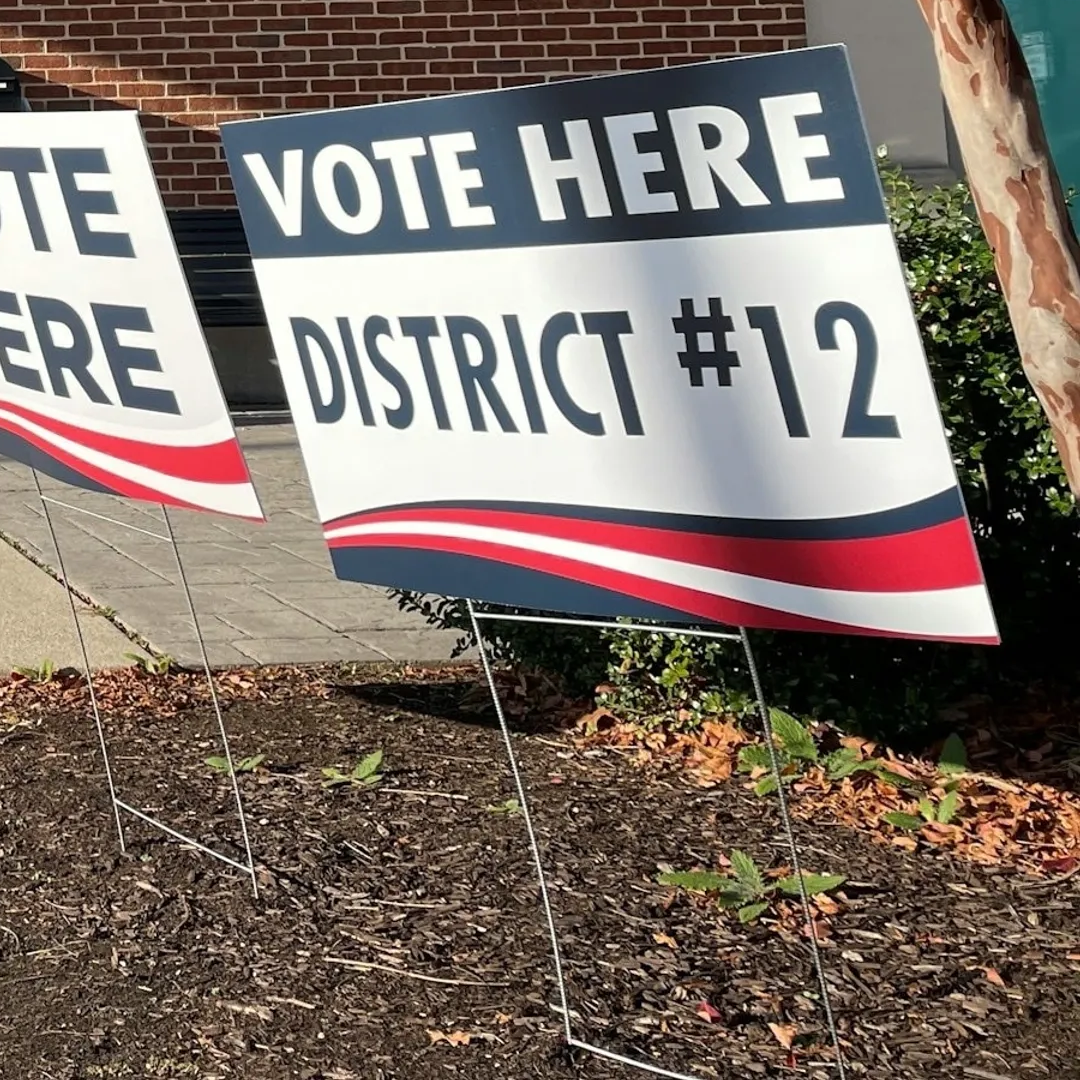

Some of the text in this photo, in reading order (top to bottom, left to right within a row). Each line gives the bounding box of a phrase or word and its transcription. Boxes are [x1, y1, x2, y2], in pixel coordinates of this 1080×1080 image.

[242, 91, 845, 237] VOTE HERE
[288, 297, 901, 439] DISTRICT #12
